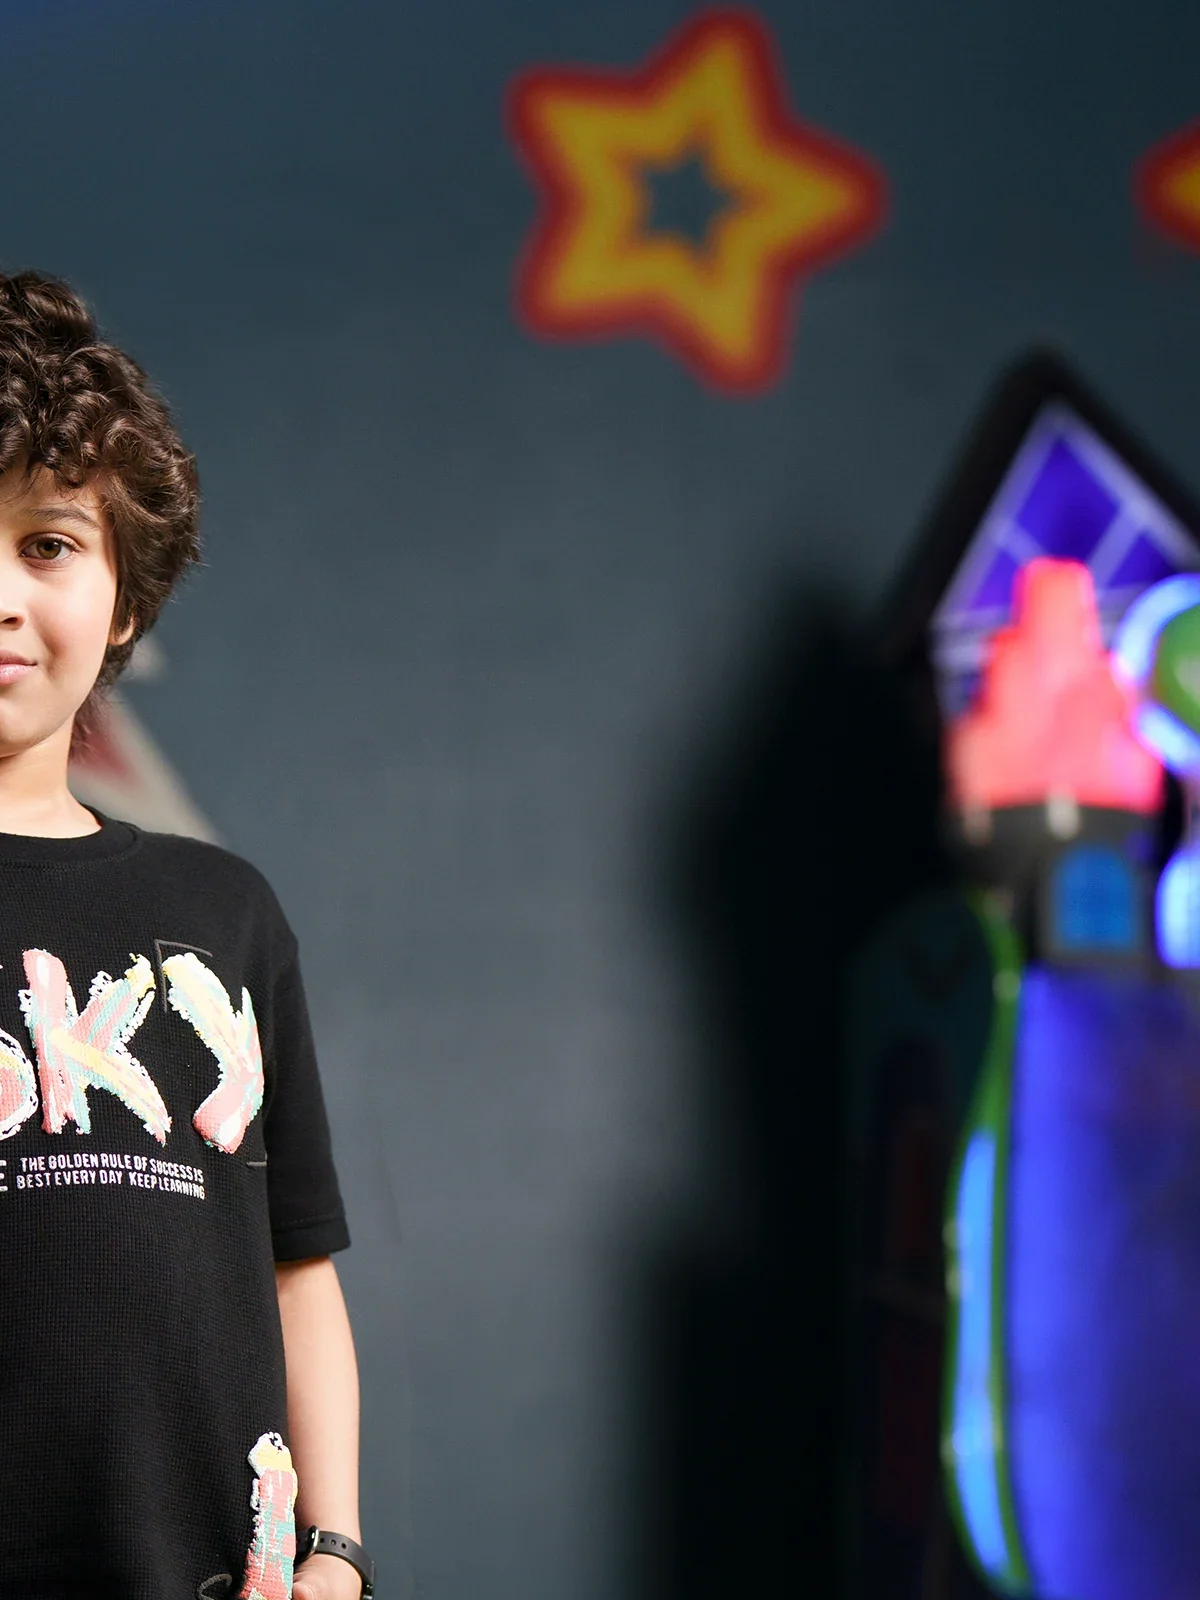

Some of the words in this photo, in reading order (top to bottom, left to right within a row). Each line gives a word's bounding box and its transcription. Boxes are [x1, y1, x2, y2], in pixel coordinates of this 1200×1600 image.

[20, 1156, 46, 1172] THE
[100, 1153, 132, 1170] RULE
[133, 1155, 148, 1172] OF
[149, 1158, 194, 1181] SUCCESS
[193, 1167, 204, 1184] IS
[16, 1172, 51, 1190] BEST
[54, 1169, 96, 1186] EVERY
[99, 1169, 123, 1185] DAY
[128, 1171, 157, 1189] KEEP
[158, 1176, 206, 1200] LEARNING
